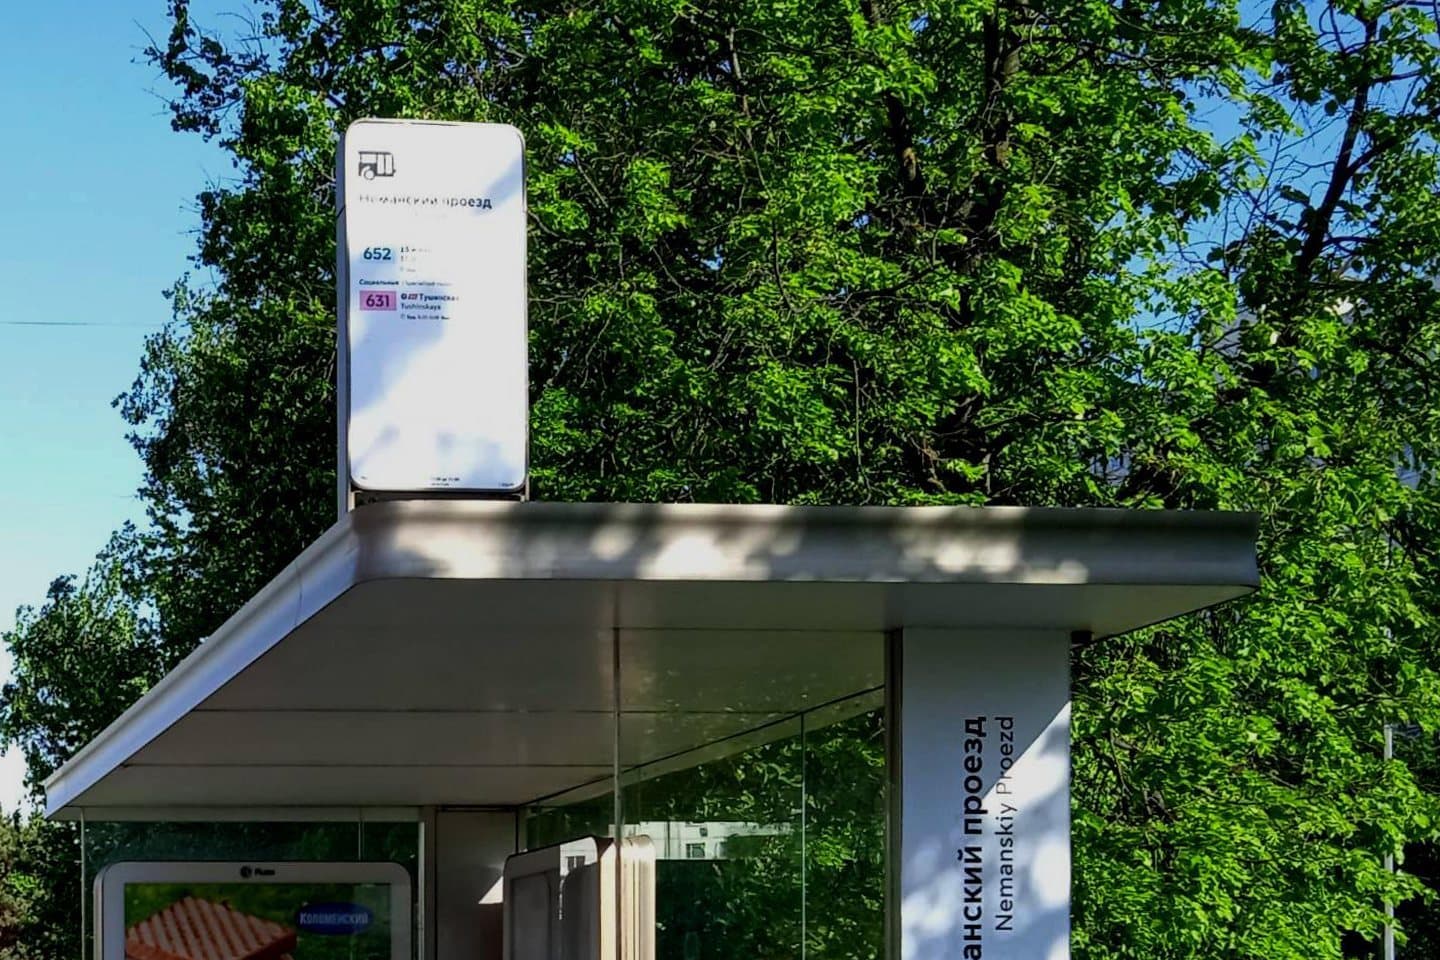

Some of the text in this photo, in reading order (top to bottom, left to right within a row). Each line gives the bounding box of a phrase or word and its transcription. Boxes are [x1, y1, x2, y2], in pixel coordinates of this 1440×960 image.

[363, 247, 392, 261] 652
[365, 294, 390, 308] 631
[963, 716, 988, 835] проезд
[994, 717, 1018, 931] Nemanskiy Proezd
